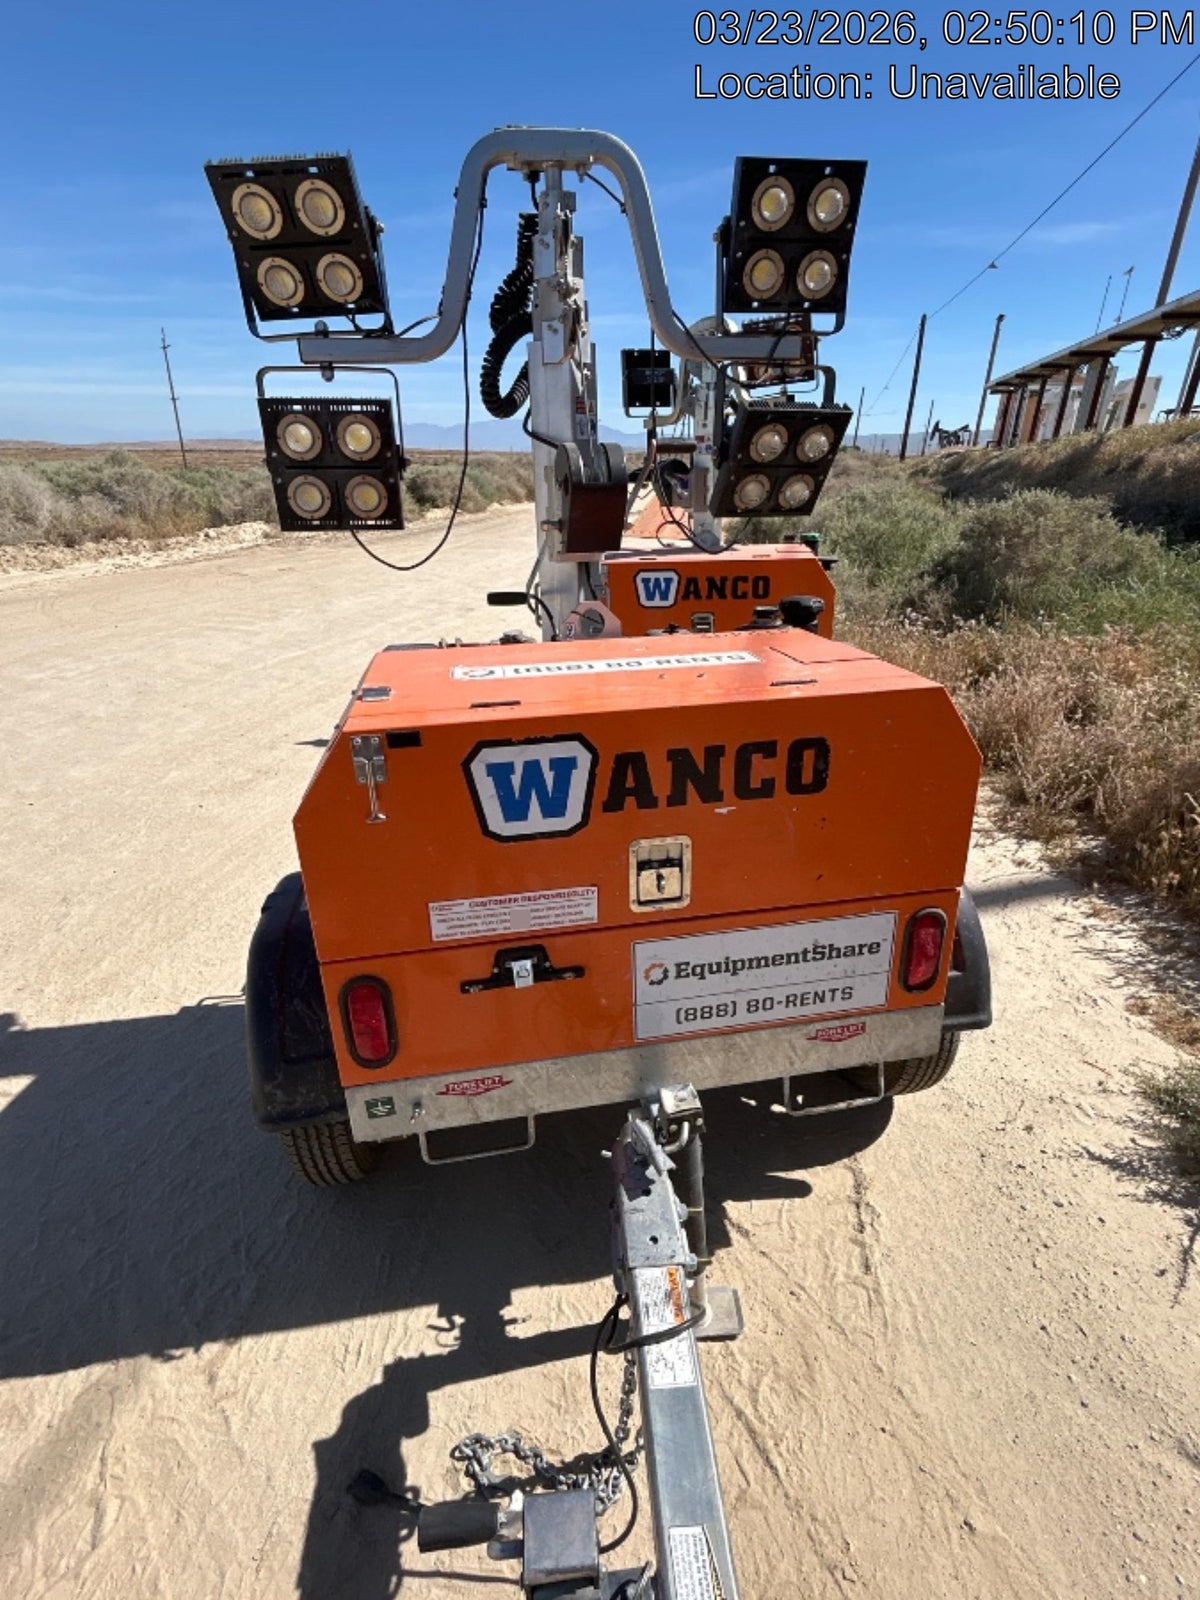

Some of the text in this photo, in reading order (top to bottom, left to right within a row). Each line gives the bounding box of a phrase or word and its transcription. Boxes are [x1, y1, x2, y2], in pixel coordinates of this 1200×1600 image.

[641, 576, 770, 601] WANCO
[485, 737, 831, 824] WANCO
[673, 940, 882, 980] EquipmentShare
[675, 986, 854, 1025] (888) 80-RENTS
